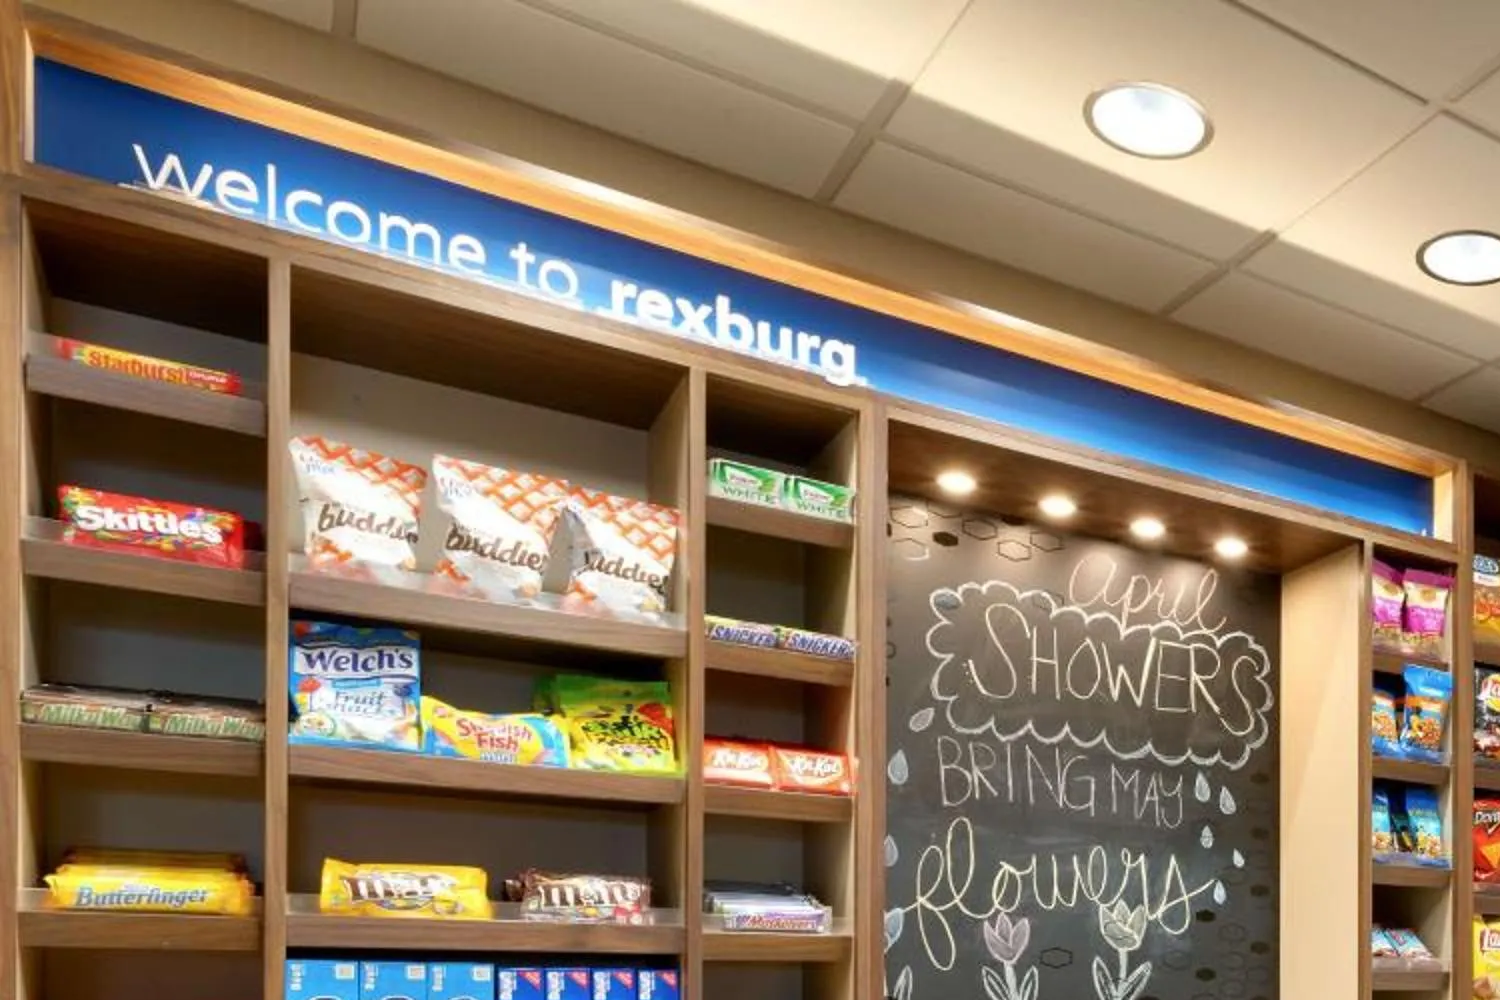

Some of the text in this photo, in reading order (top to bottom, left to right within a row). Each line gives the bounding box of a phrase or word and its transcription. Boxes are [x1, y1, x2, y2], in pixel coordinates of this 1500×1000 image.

[132, 143, 857, 387] welcome to rexburg
[76, 505, 224, 545] Skittles
[1068, 553, 1227, 639] April
[302, 648, 413, 673] Welch's
[966, 603, 1261, 737] SHOWERS
[936, 735, 1184, 829] BRING MAY
[76, 885, 209, 909] Butterfinger
[900, 816, 1217, 971] flowers
